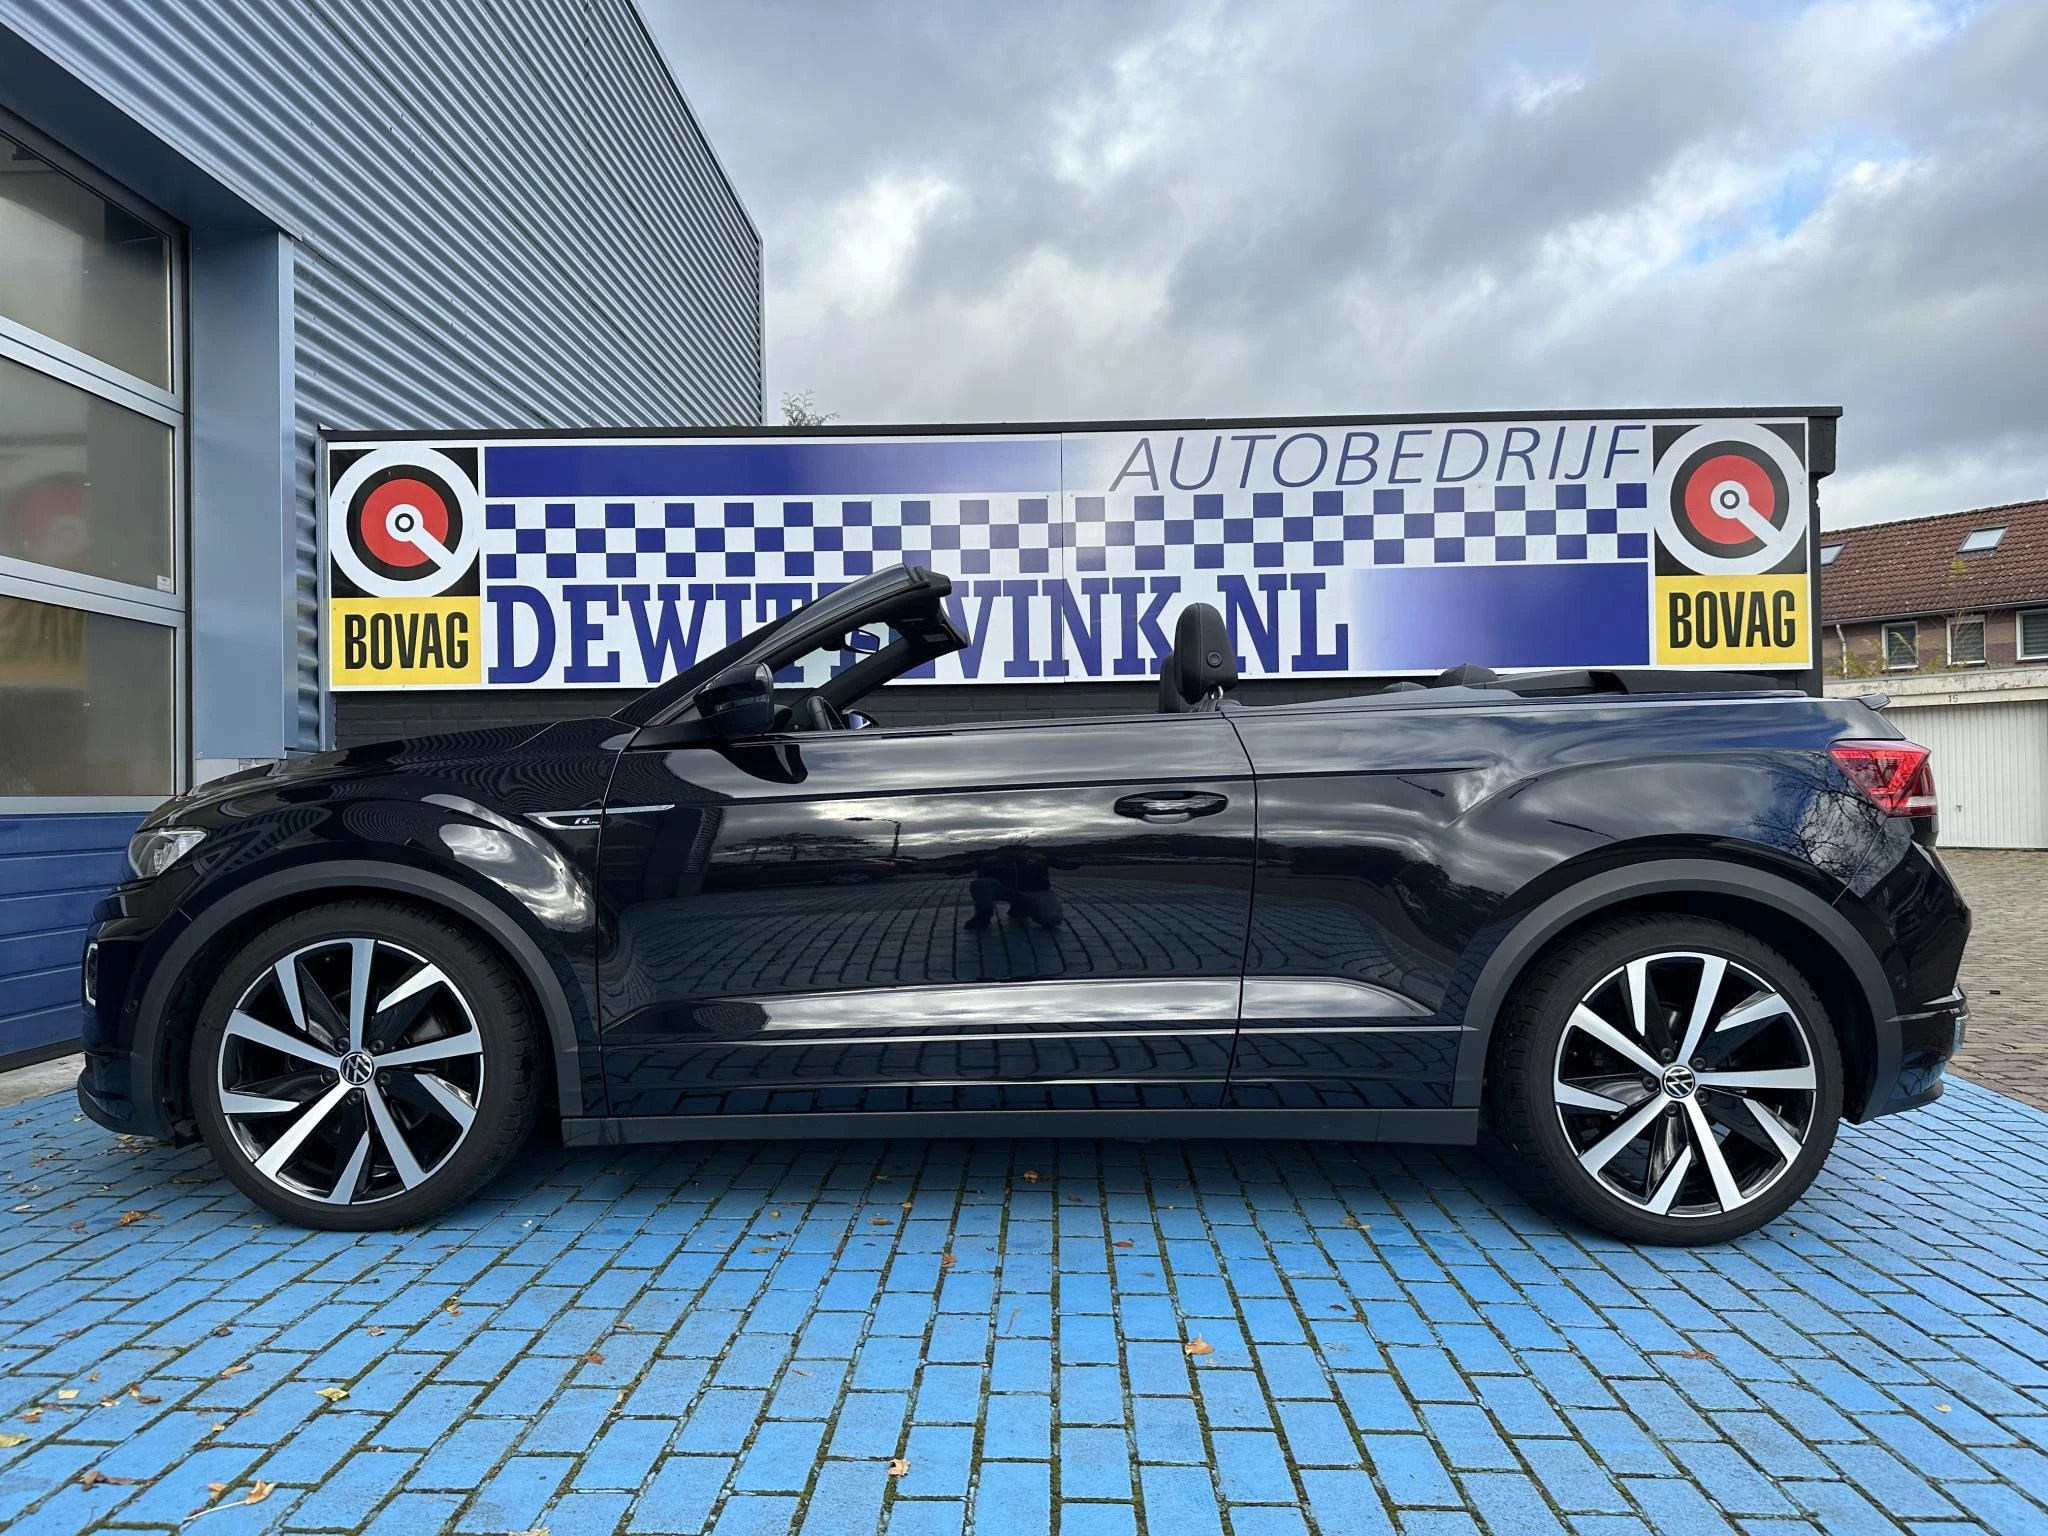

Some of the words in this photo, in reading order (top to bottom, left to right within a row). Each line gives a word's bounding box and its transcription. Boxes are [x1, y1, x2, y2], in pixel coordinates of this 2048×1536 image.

[1108, 425, 1646, 491] AUTOBEDRIJF
[344, 611, 469, 670] BOVAG
[1669, 589, 1796, 649] BOVAG
